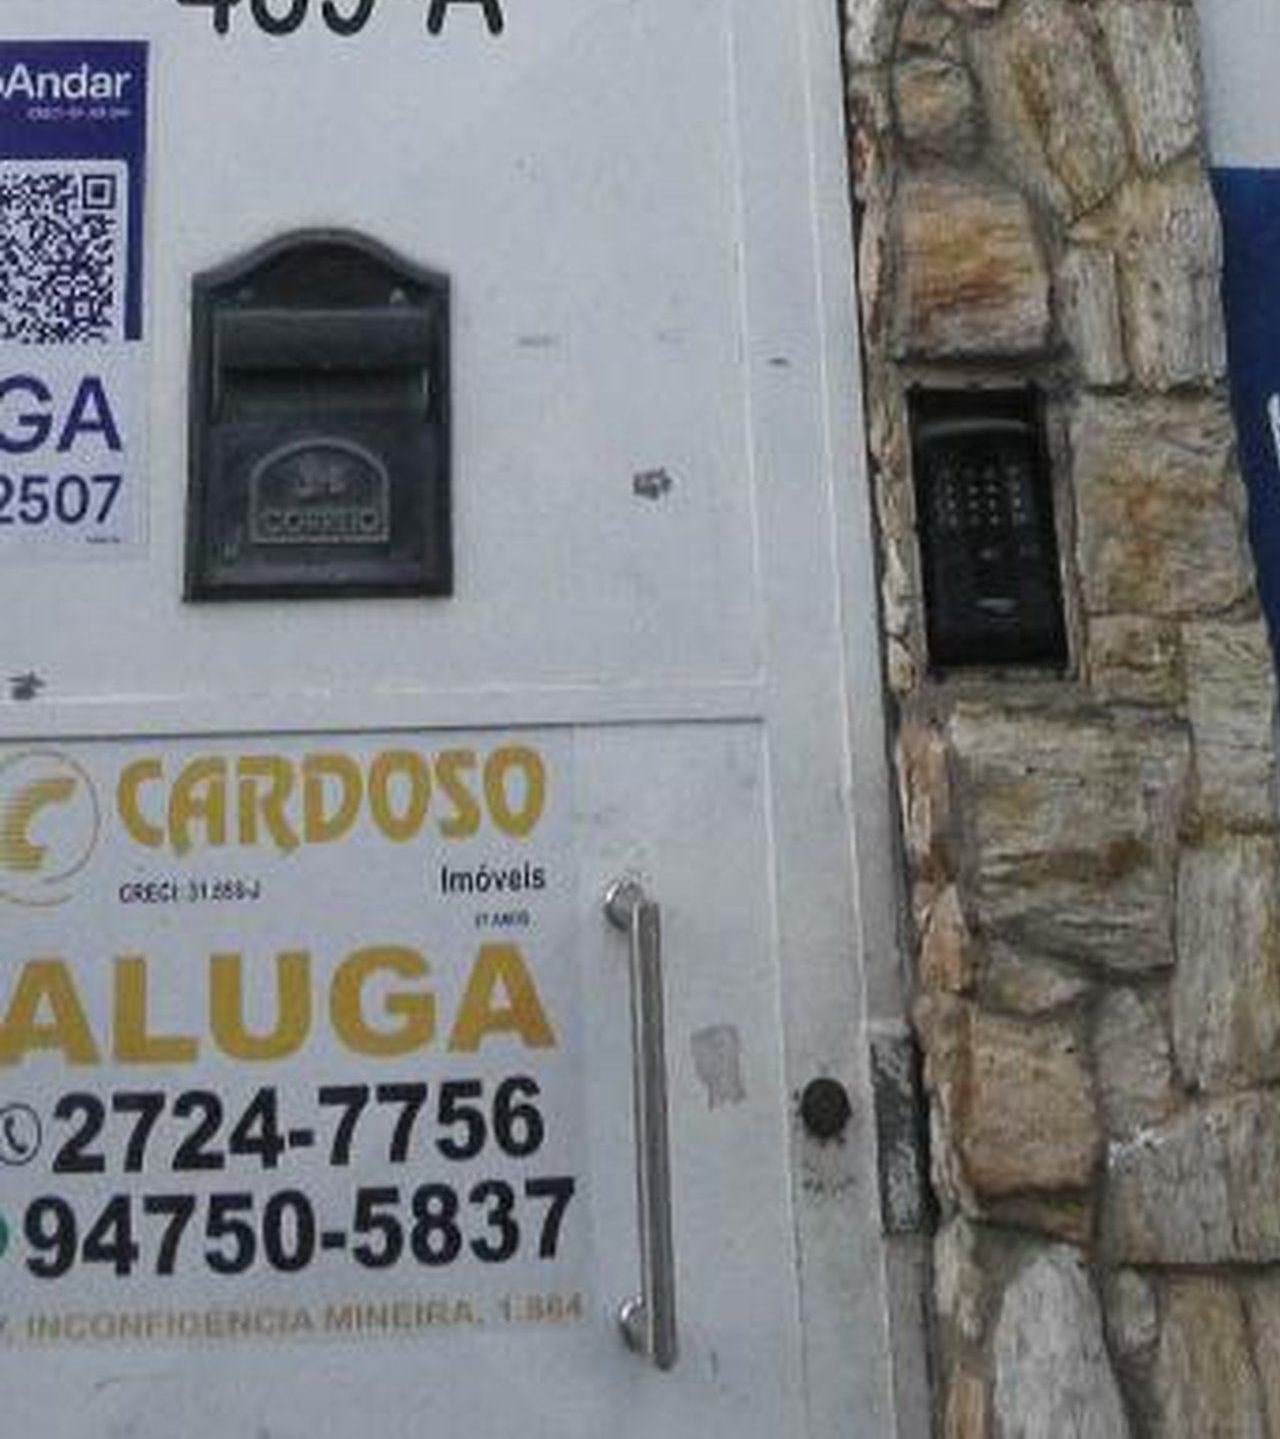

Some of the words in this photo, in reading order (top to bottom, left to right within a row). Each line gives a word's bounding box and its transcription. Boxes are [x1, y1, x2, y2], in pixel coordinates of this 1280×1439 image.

[0, 63, 132, 100] Andar
[116, 744, 547, 858] CARDOSO
[441, 862, 546, 895] Imóveis
[0, 942, 555, 1066] ALUGA
[51, 1077, 545, 1173] 2724-7756
[24, 1177, 576, 1278] 94750-5837
